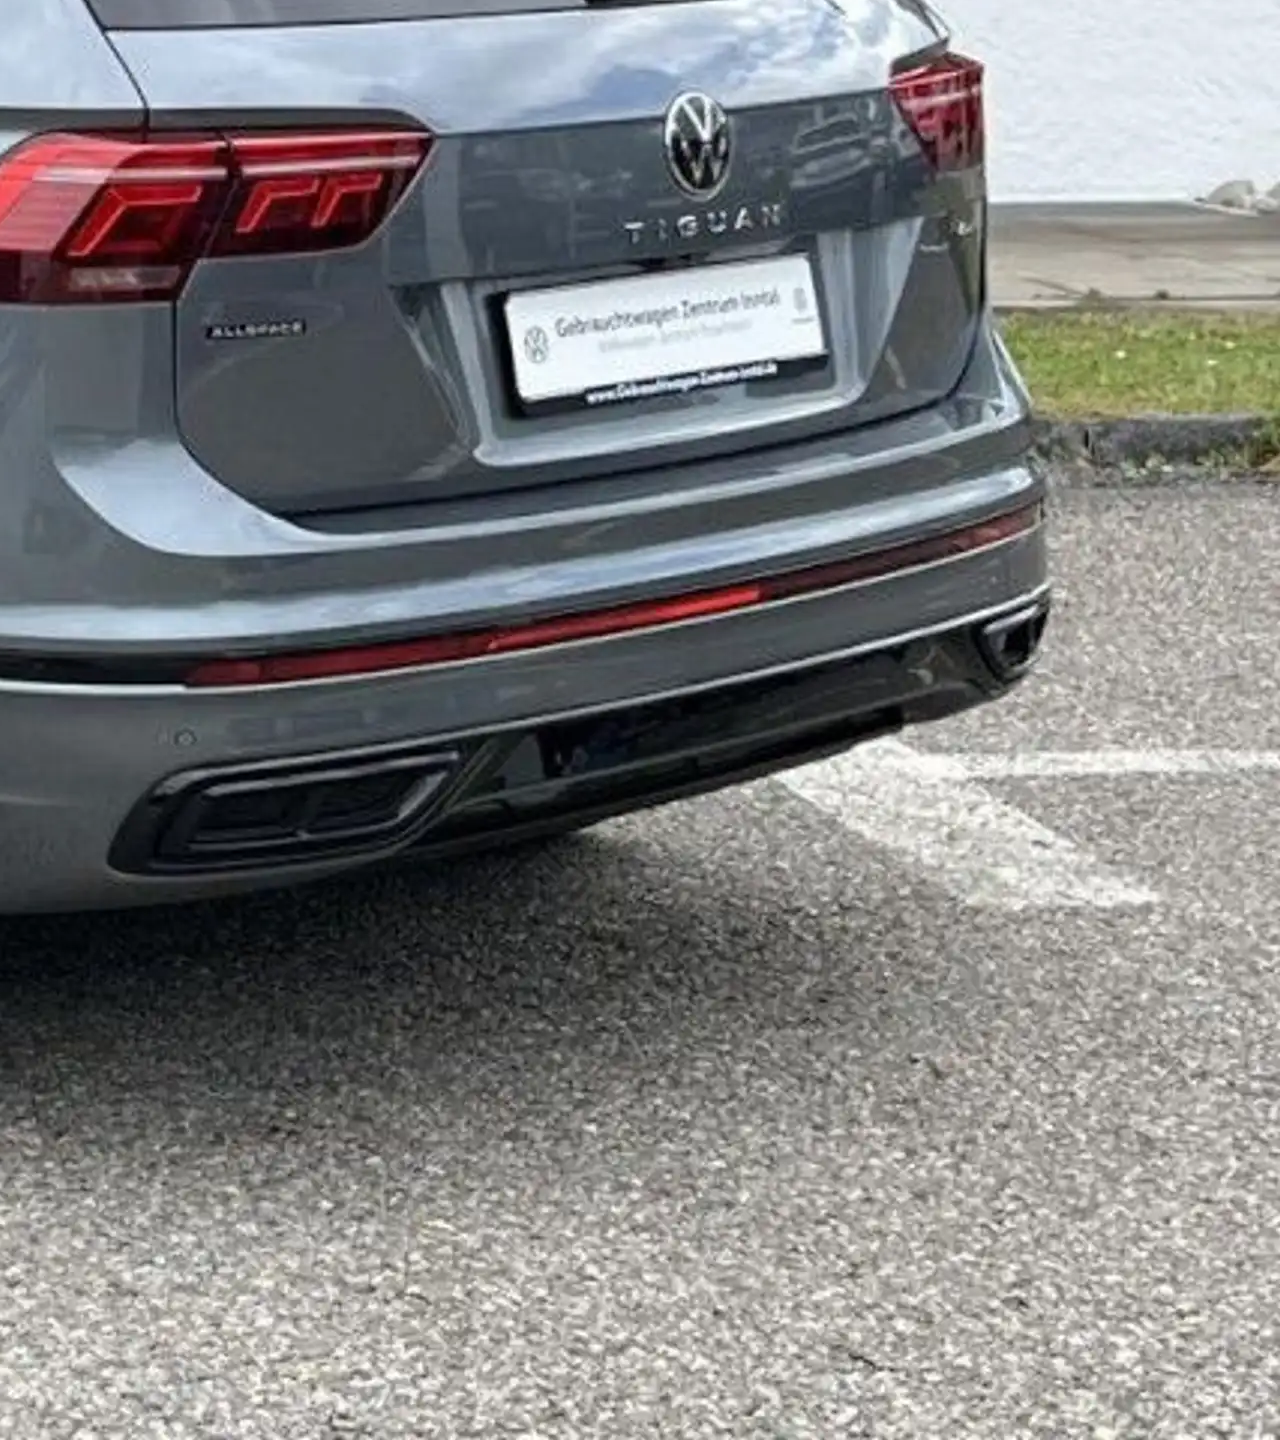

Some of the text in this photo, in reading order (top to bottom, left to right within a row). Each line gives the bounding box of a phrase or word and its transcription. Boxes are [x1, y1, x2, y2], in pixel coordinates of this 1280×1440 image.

[622, 203, 782, 245] TIGUAN
[209, 321, 304, 338] ALLSPACE
[554, 304, 678, 338] Gebrauchtwagen
[680, 296, 738, 321] Zentrum
